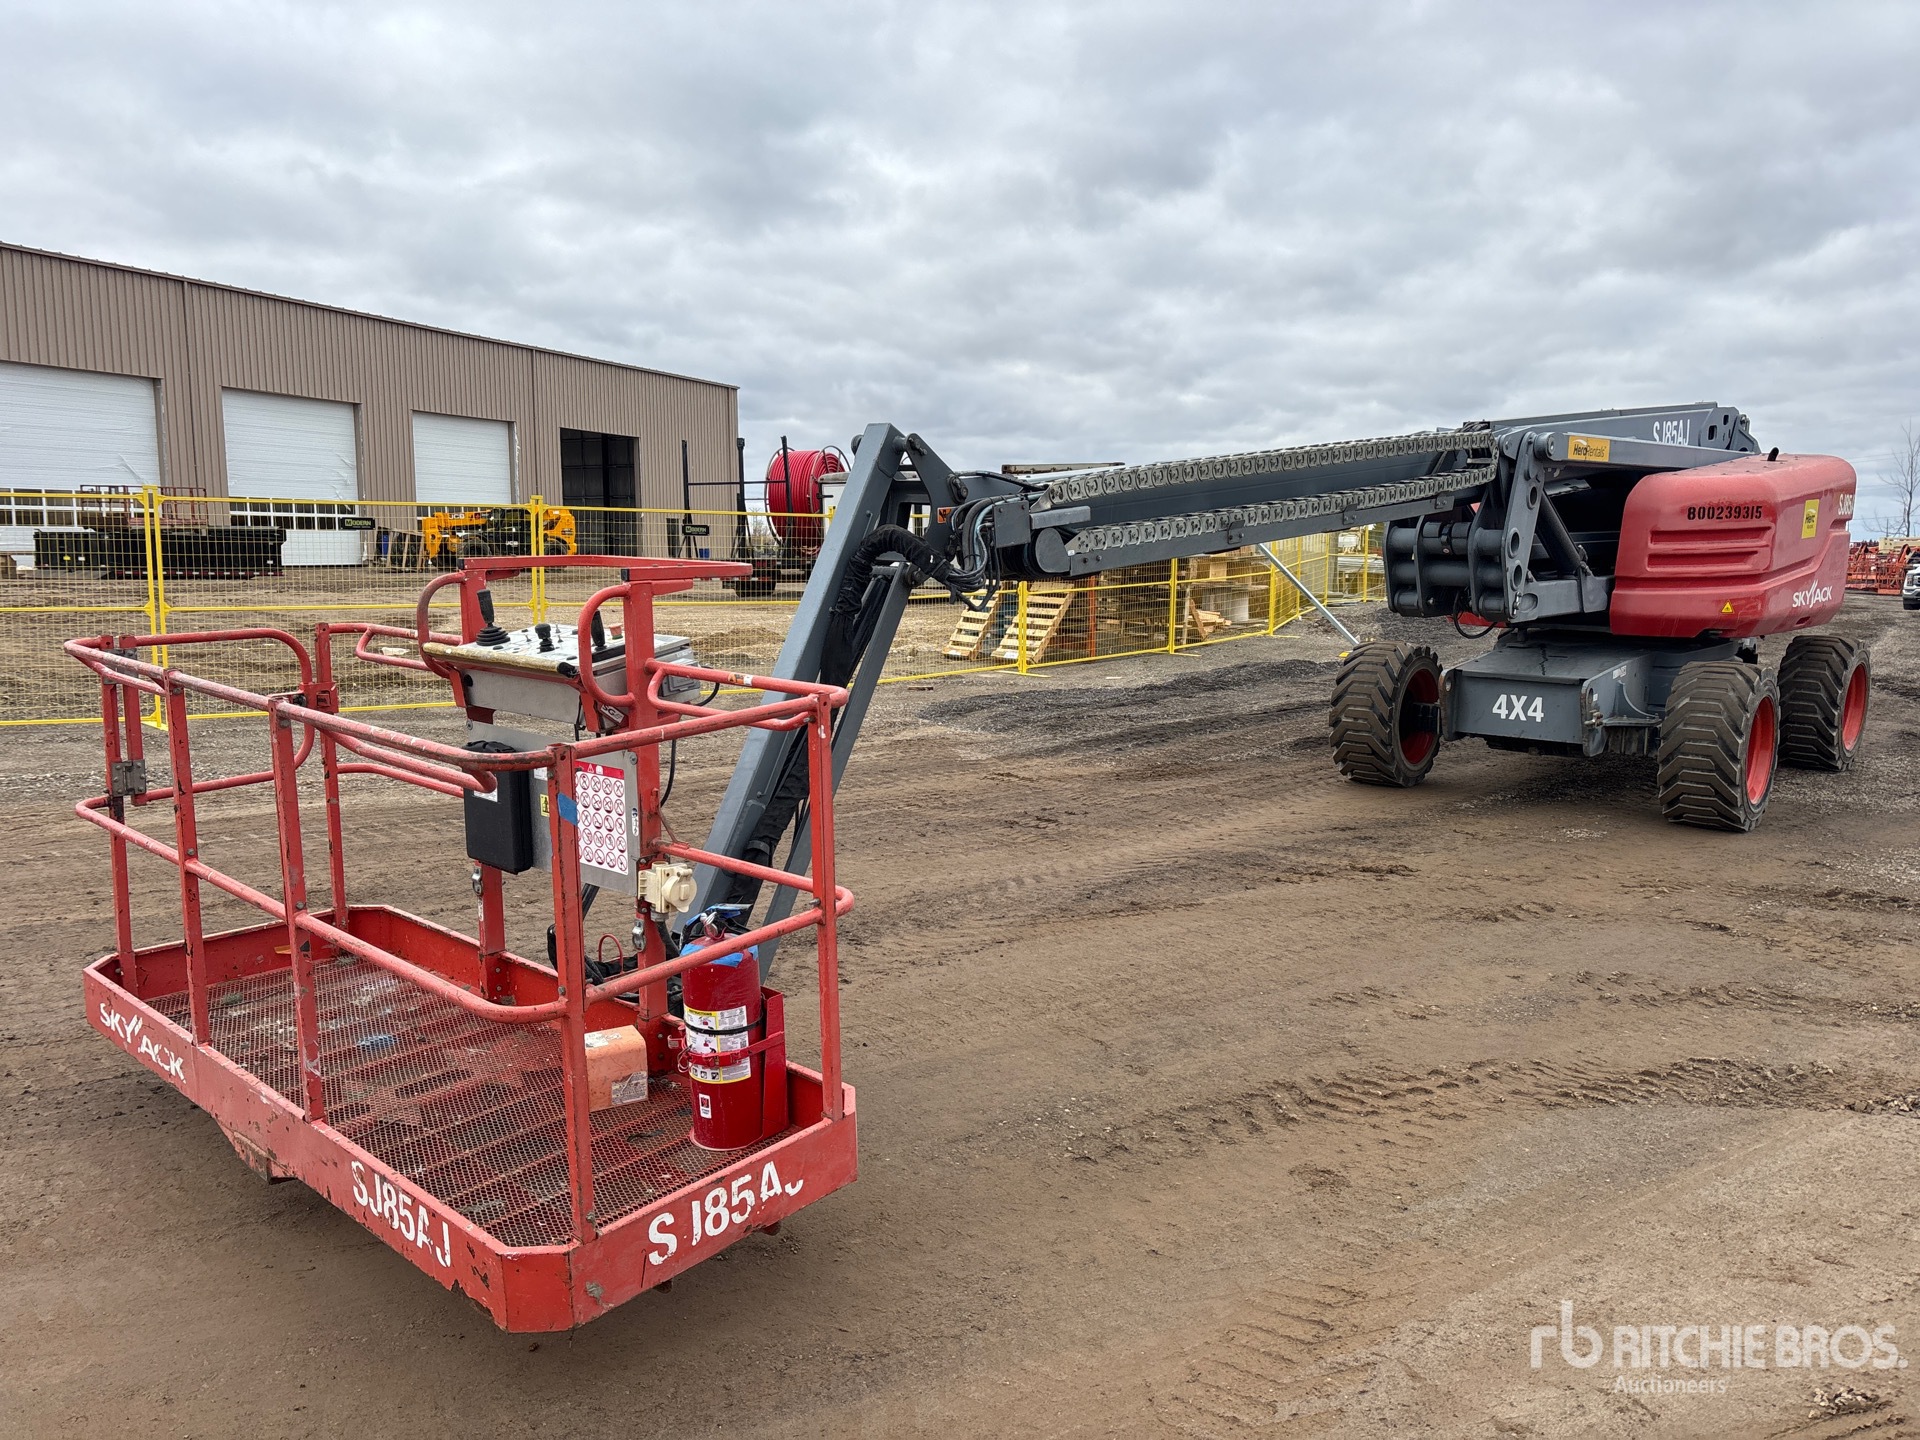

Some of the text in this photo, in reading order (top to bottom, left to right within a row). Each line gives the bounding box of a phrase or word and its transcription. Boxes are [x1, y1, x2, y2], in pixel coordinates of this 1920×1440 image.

[344, 518, 372, 527] MODERN
[448, 512, 465, 520] JCB
[1792, 579, 1833, 609] SKYJACK
[1492, 694, 1545, 723] 4X4
[351, 1160, 451, 1268] SJ85AJ
